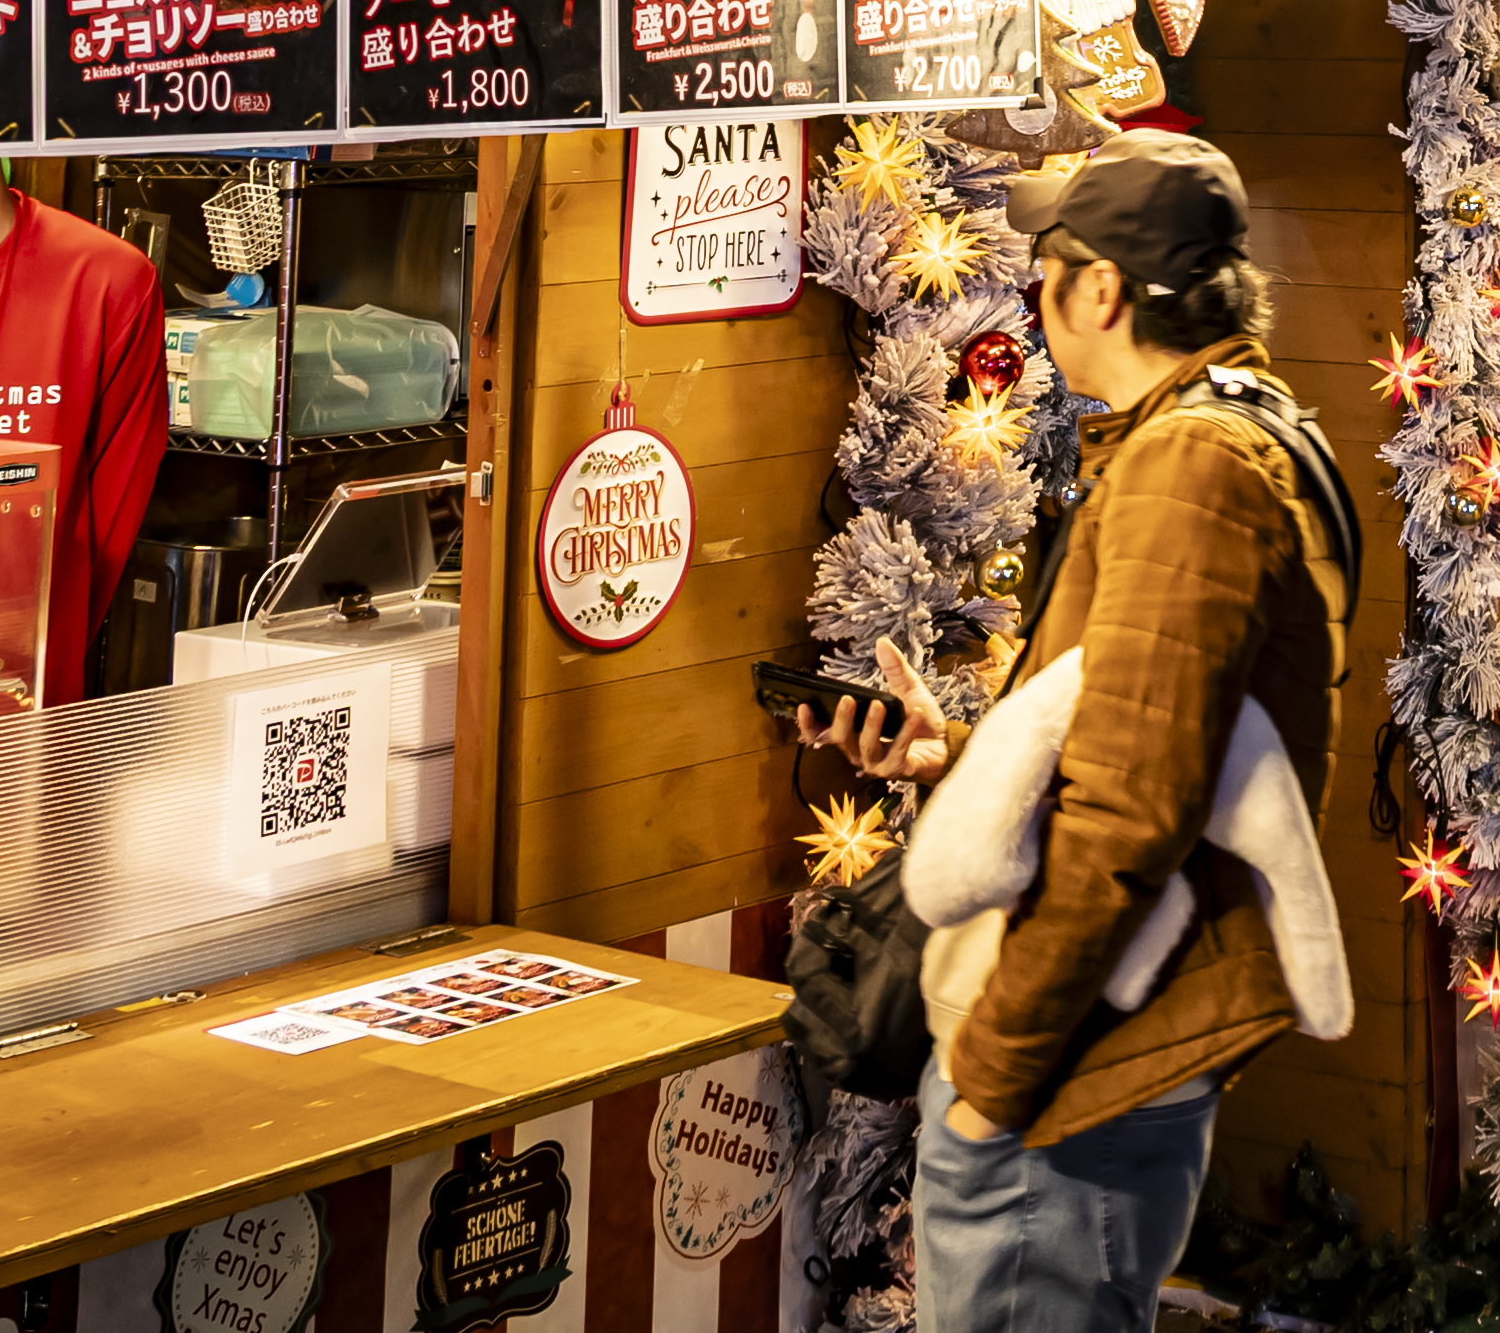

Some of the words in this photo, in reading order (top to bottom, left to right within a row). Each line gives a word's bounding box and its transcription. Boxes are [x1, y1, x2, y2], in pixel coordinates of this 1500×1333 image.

[84, 69, 91, 80] 2
[93, 66, 122, 78] kinds
[123, 63, 135, 75] of
[137, 58, 184, 72] sausages
[186, 55, 209, 67] with
[211, 51, 245, 64] cheese
[247, 47, 276, 58] sauce
[363, 9, 515, 69] 盛り合わせ
[117, 71, 232, 120] ¥1,300
[428, 68, 529, 112] ¥1,800
[661, 123, 782, 178] SANTA
[662, 169, 792, 246] please
[675, 233, 718, 273] STOP
[725, 230, 766, 269] HERE
[575, 470, 666, 531] MERRY
[549, 517, 681, 585] CHRISTMAS
[700, 1080, 778, 1134] Happy
[674, 1119, 780, 1178] Holidays
[467, 1199, 526, 1240] SCHÖNE
[454, 1221, 536, 1270] FEIERTAGE!
[214, 1250, 288, 1301] enjoy
[192, 1284, 267, 1333] Xmas
